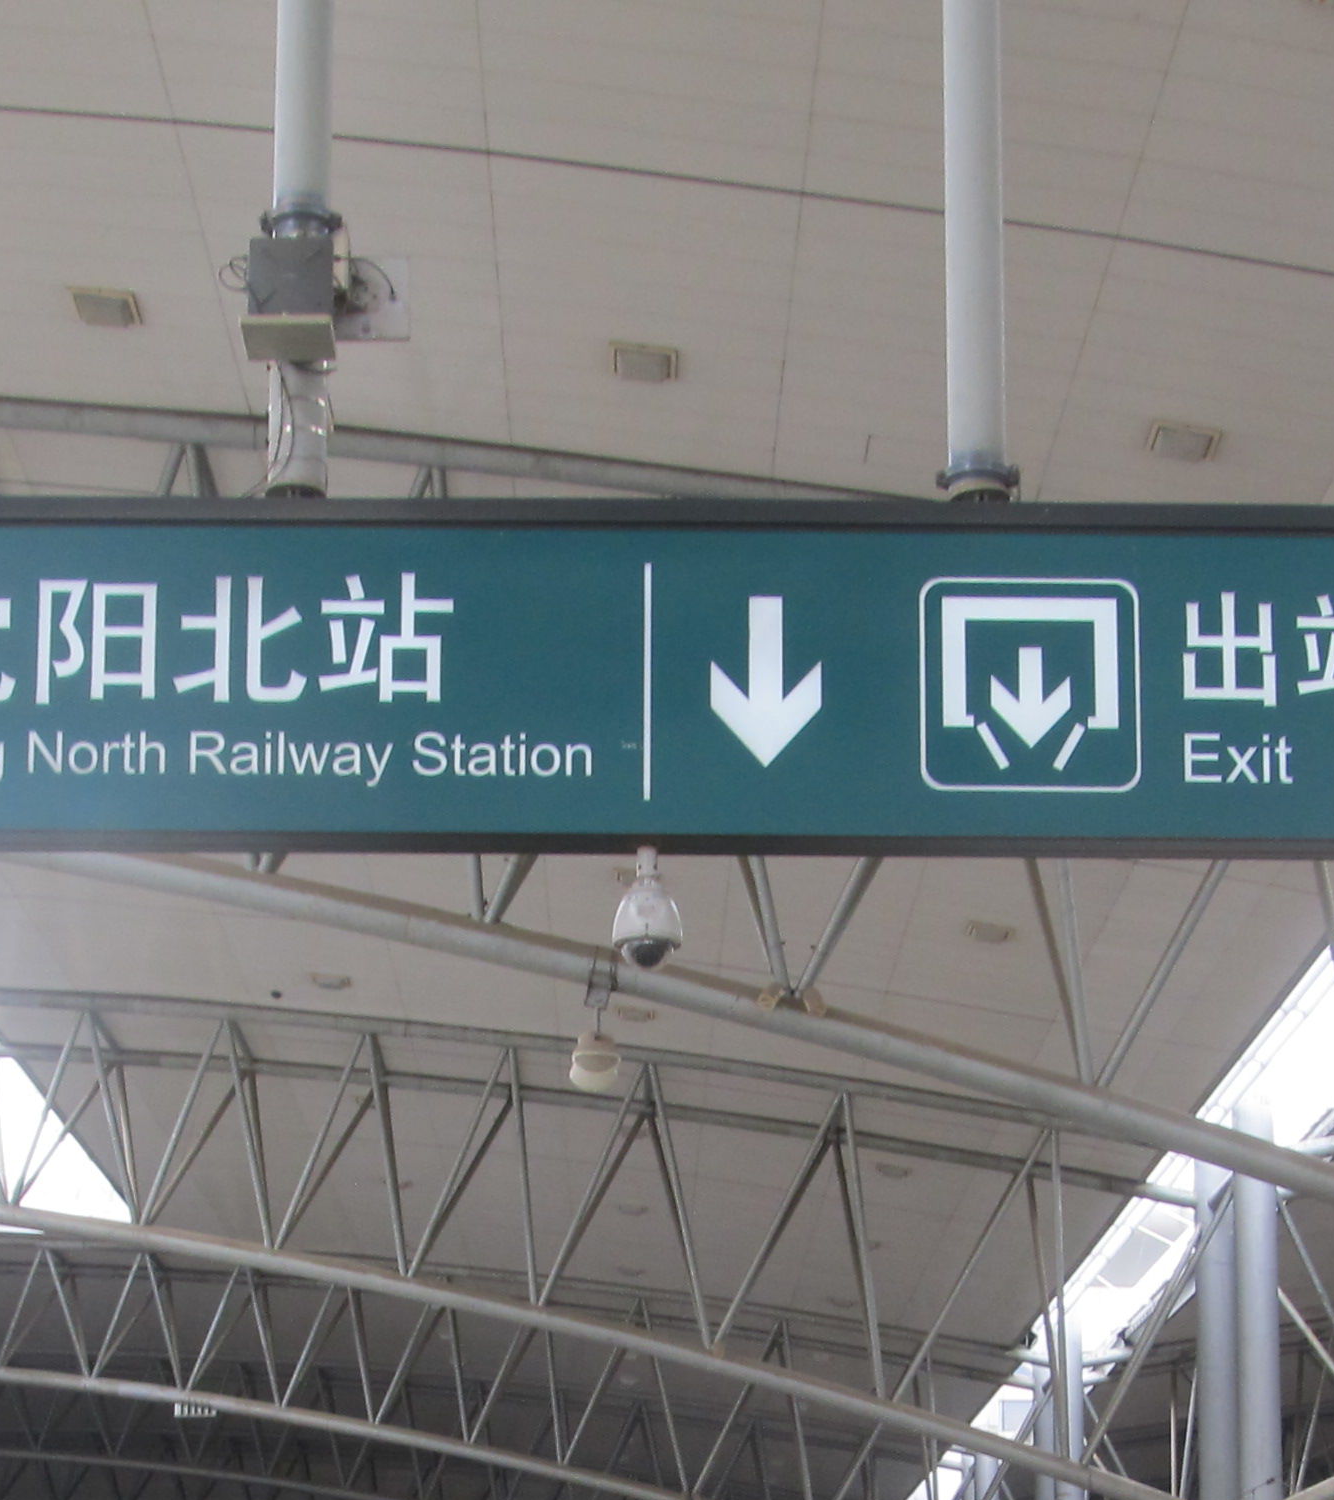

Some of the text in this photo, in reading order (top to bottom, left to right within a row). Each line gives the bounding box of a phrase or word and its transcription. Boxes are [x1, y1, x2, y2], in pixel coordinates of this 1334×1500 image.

[27, 730, 167, 776] North
[187, 730, 394, 786] Railway
[411, 732, 593, 779] Station
[1183, 732, 1293, 785] Exit
